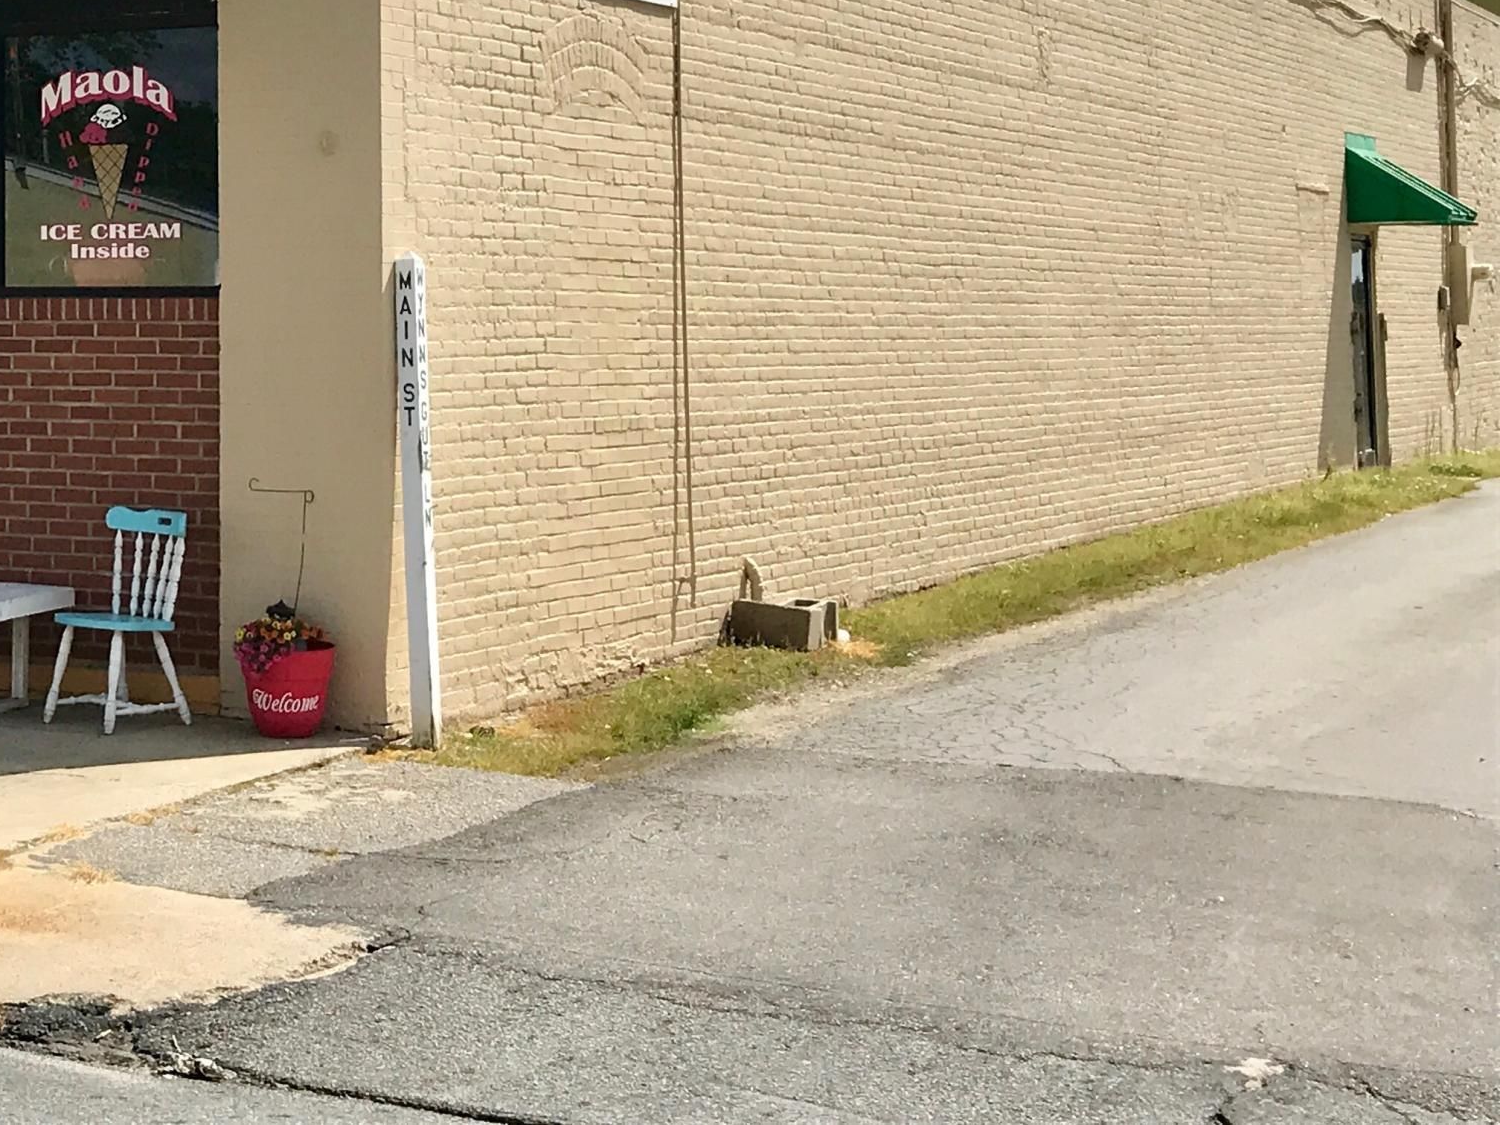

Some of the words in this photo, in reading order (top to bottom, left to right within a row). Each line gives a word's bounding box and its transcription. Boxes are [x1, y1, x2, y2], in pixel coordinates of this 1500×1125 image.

[40, 64, 178, 127] Maola
[39, 224, 83, 241] ICE
[90, 223, 181, 239] CREAM
[70, 242, 150, 259] Inside
[399, 269, 414, 368] MAIN
[402, 382, 416, 426] ST
[252, 688, 320, 713] Welcome
